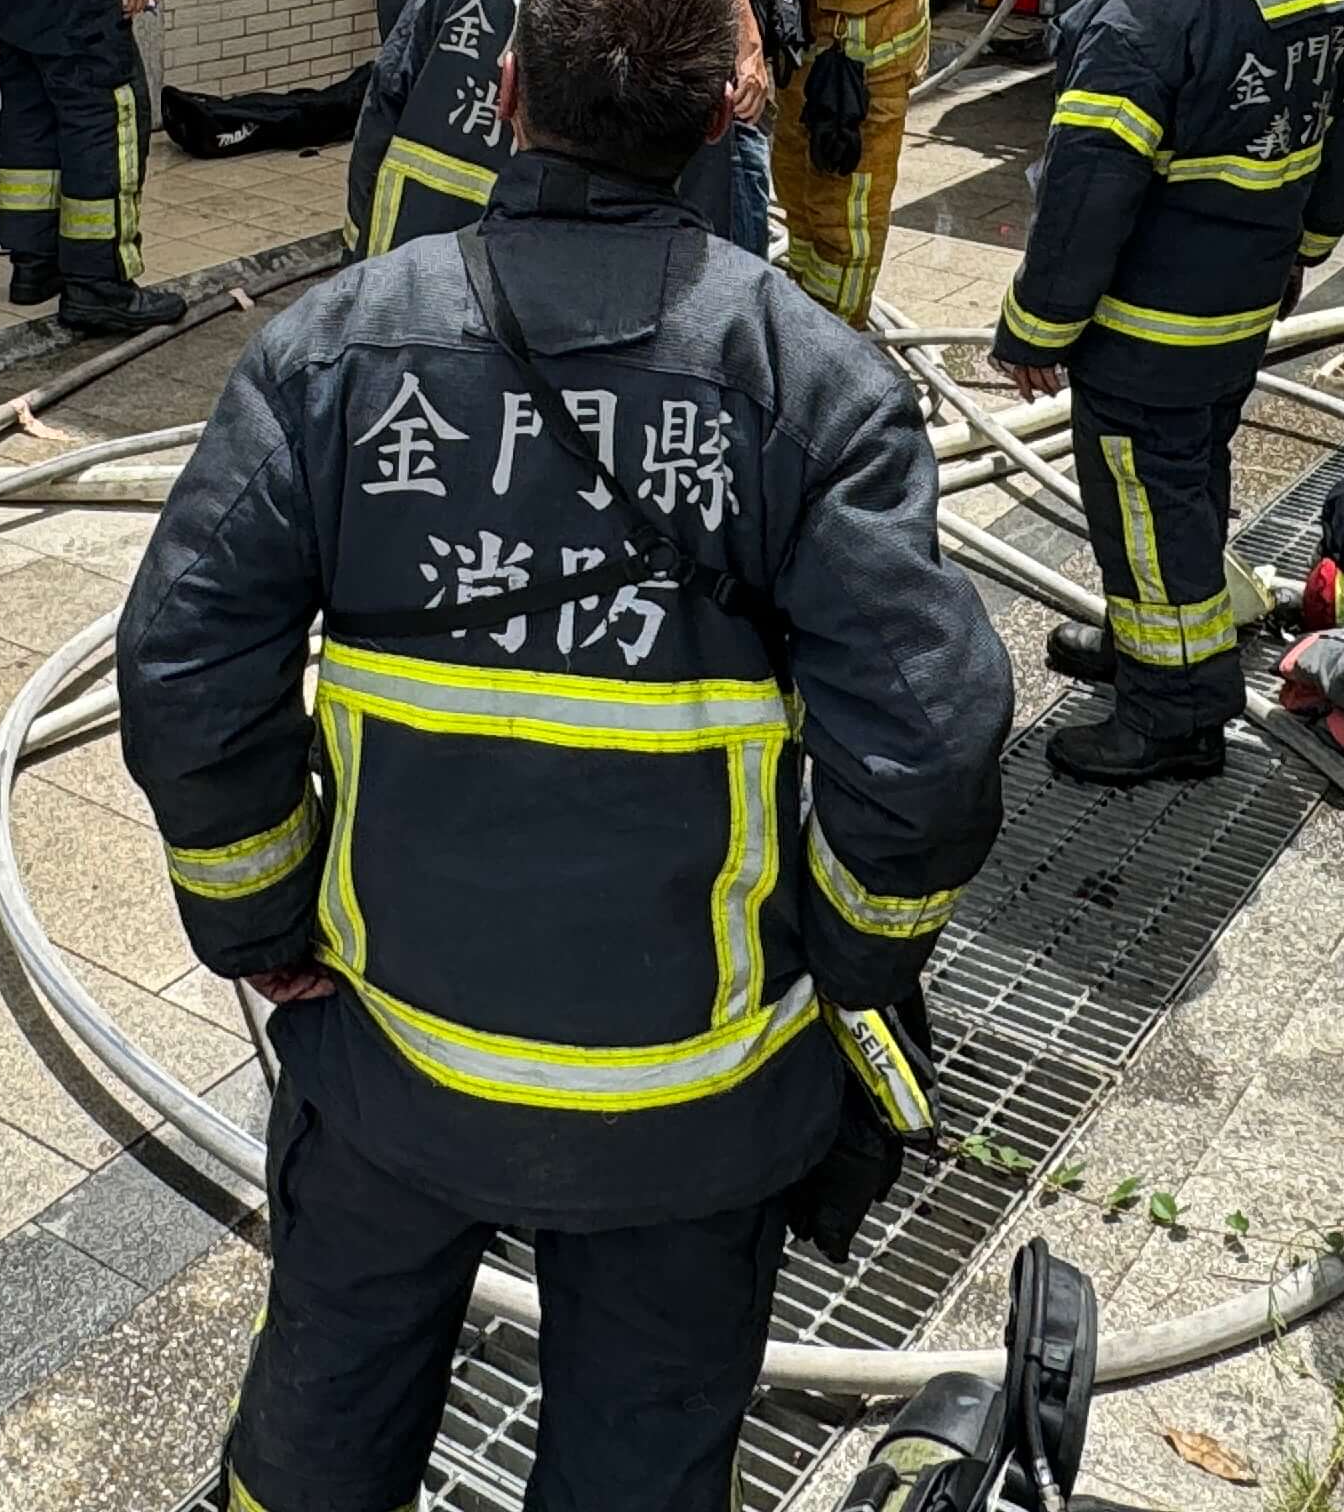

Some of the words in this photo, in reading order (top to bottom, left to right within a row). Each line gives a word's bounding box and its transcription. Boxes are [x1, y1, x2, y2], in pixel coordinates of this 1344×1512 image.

[353, 372, 741, 533] 金門縣
[418, 530, 680, 667] 消防
